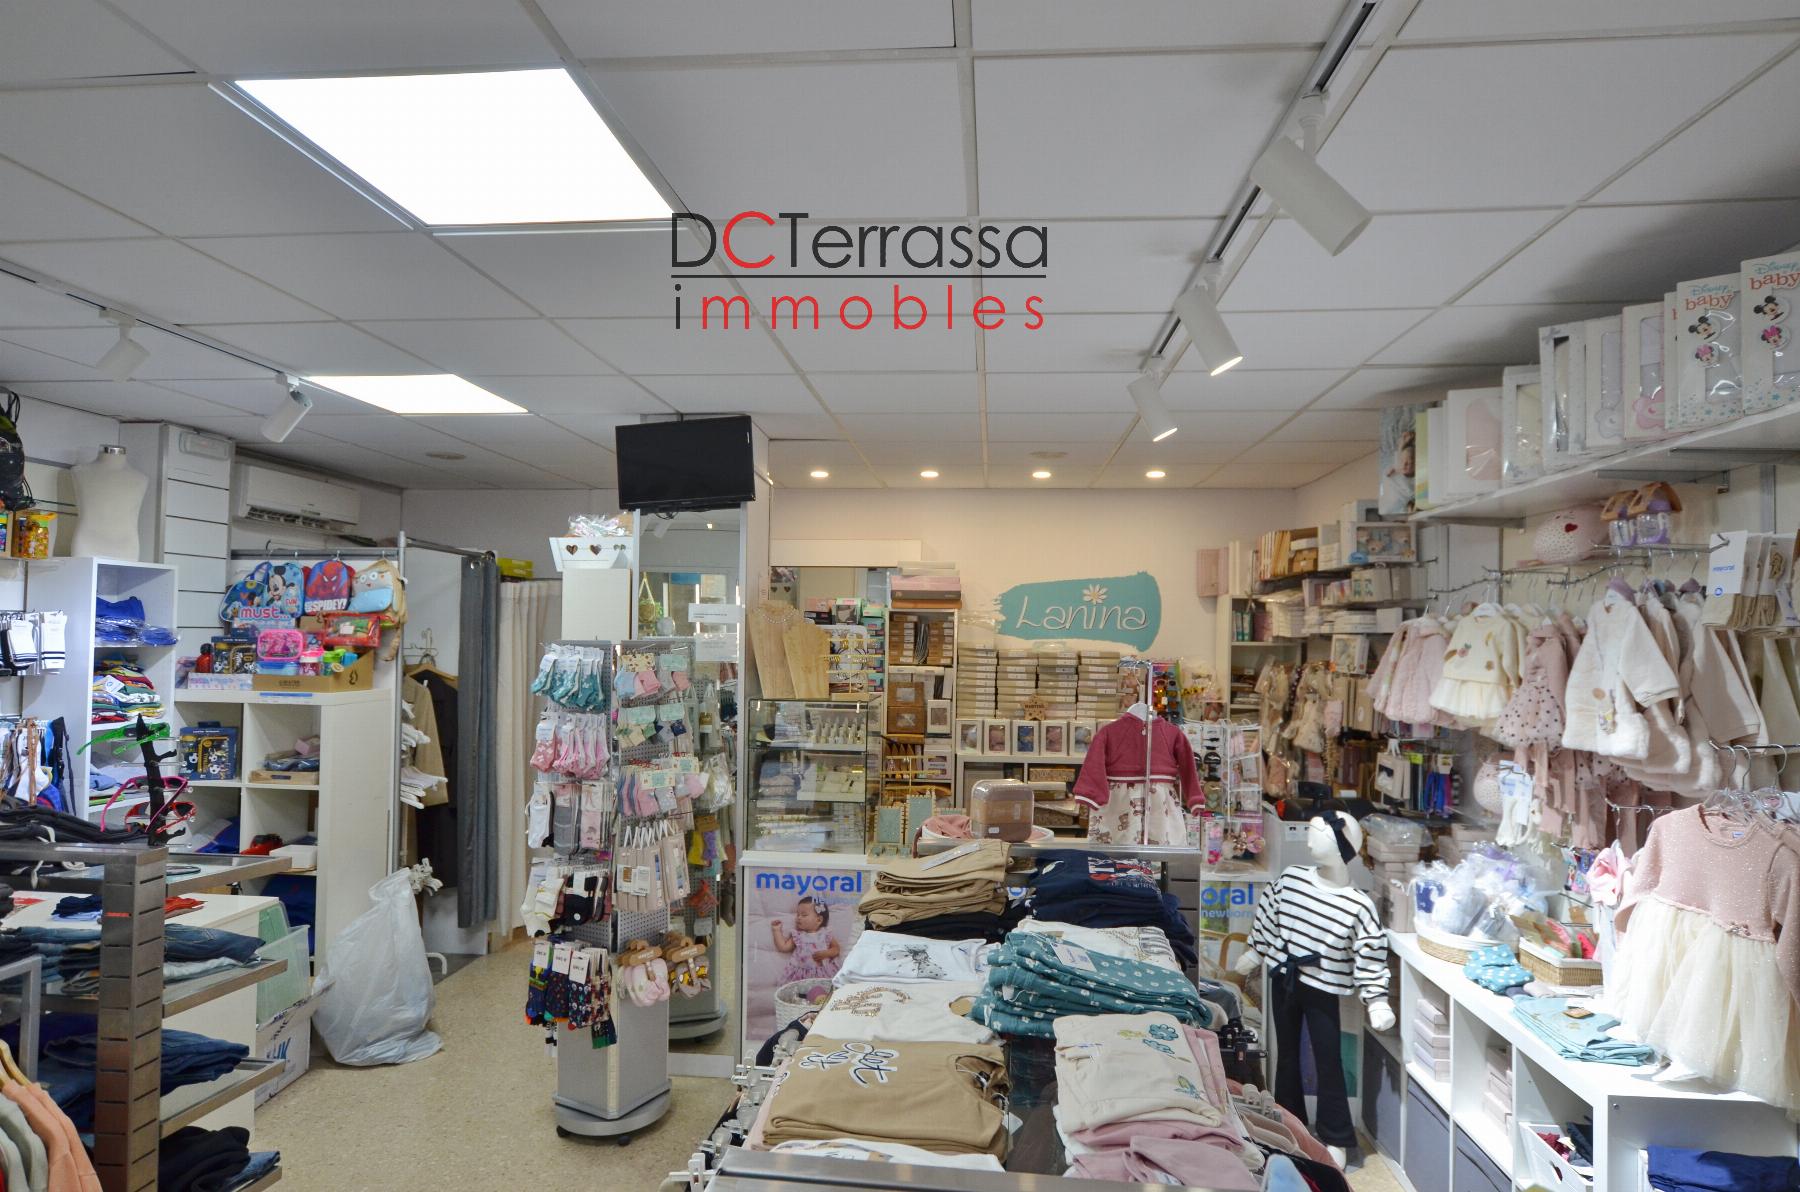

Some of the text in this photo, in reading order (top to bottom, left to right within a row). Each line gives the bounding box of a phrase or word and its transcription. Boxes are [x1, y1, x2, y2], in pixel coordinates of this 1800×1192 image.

[1749, 272, 1800, 290] baby
[1686, 294, 1733, 311] baby
[1015, 594, 1151, 631] Lanina
[756, 871, 862, 896] mayoral
[1201, 883, 1254, 906] oral
